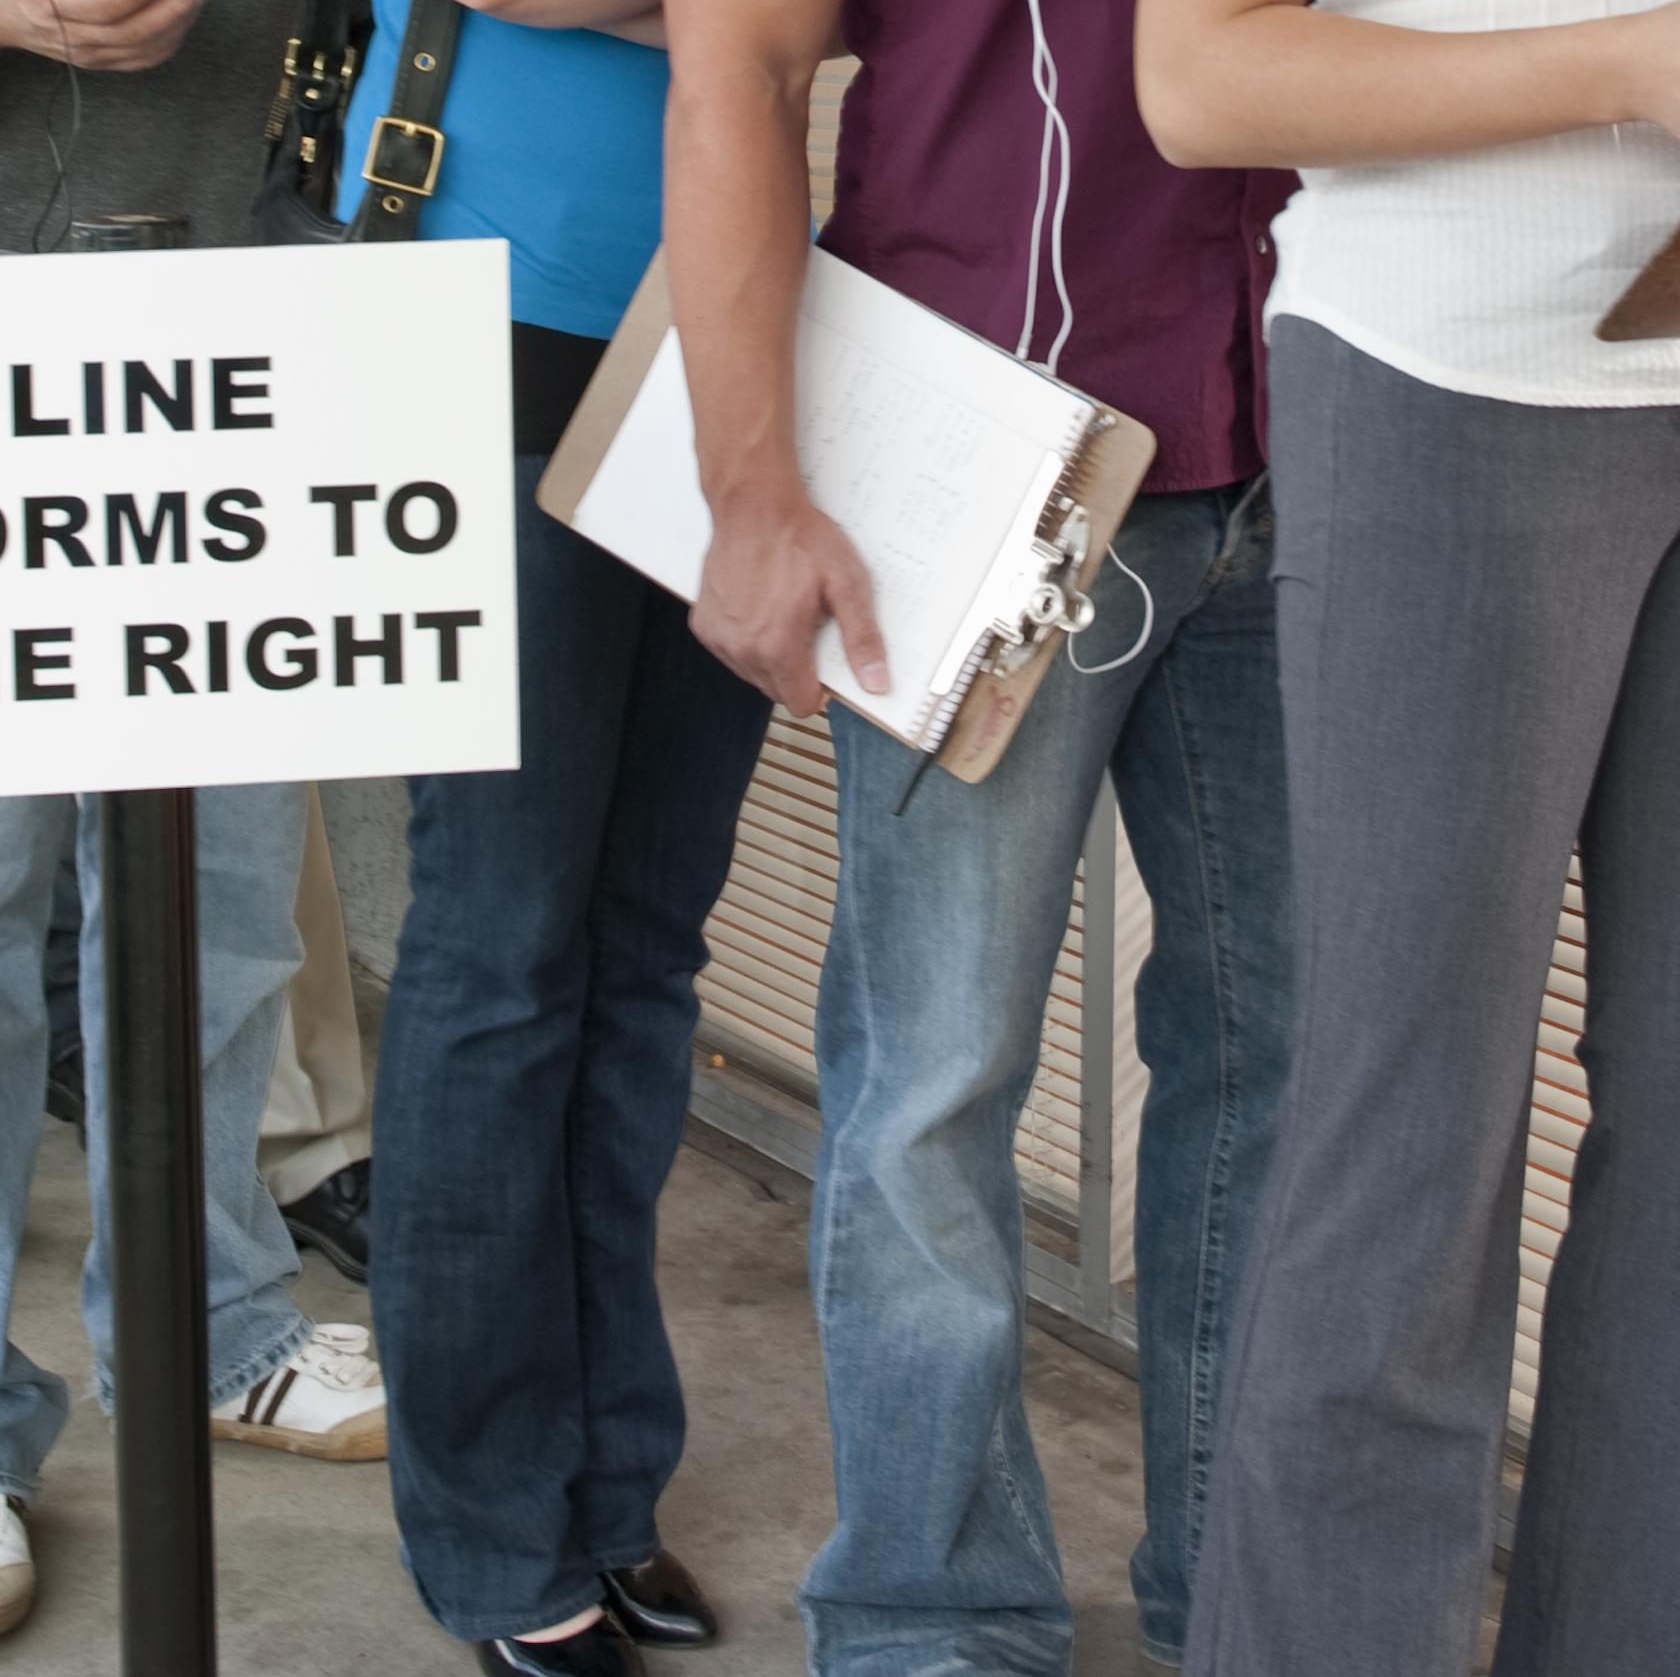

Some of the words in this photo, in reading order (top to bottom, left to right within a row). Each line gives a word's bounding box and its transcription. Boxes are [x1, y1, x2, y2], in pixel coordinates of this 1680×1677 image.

[10, 355, 274, 438] LINE
[309, 480, 459, 558] TO
[124, 609, 482, 698] RIGHT
